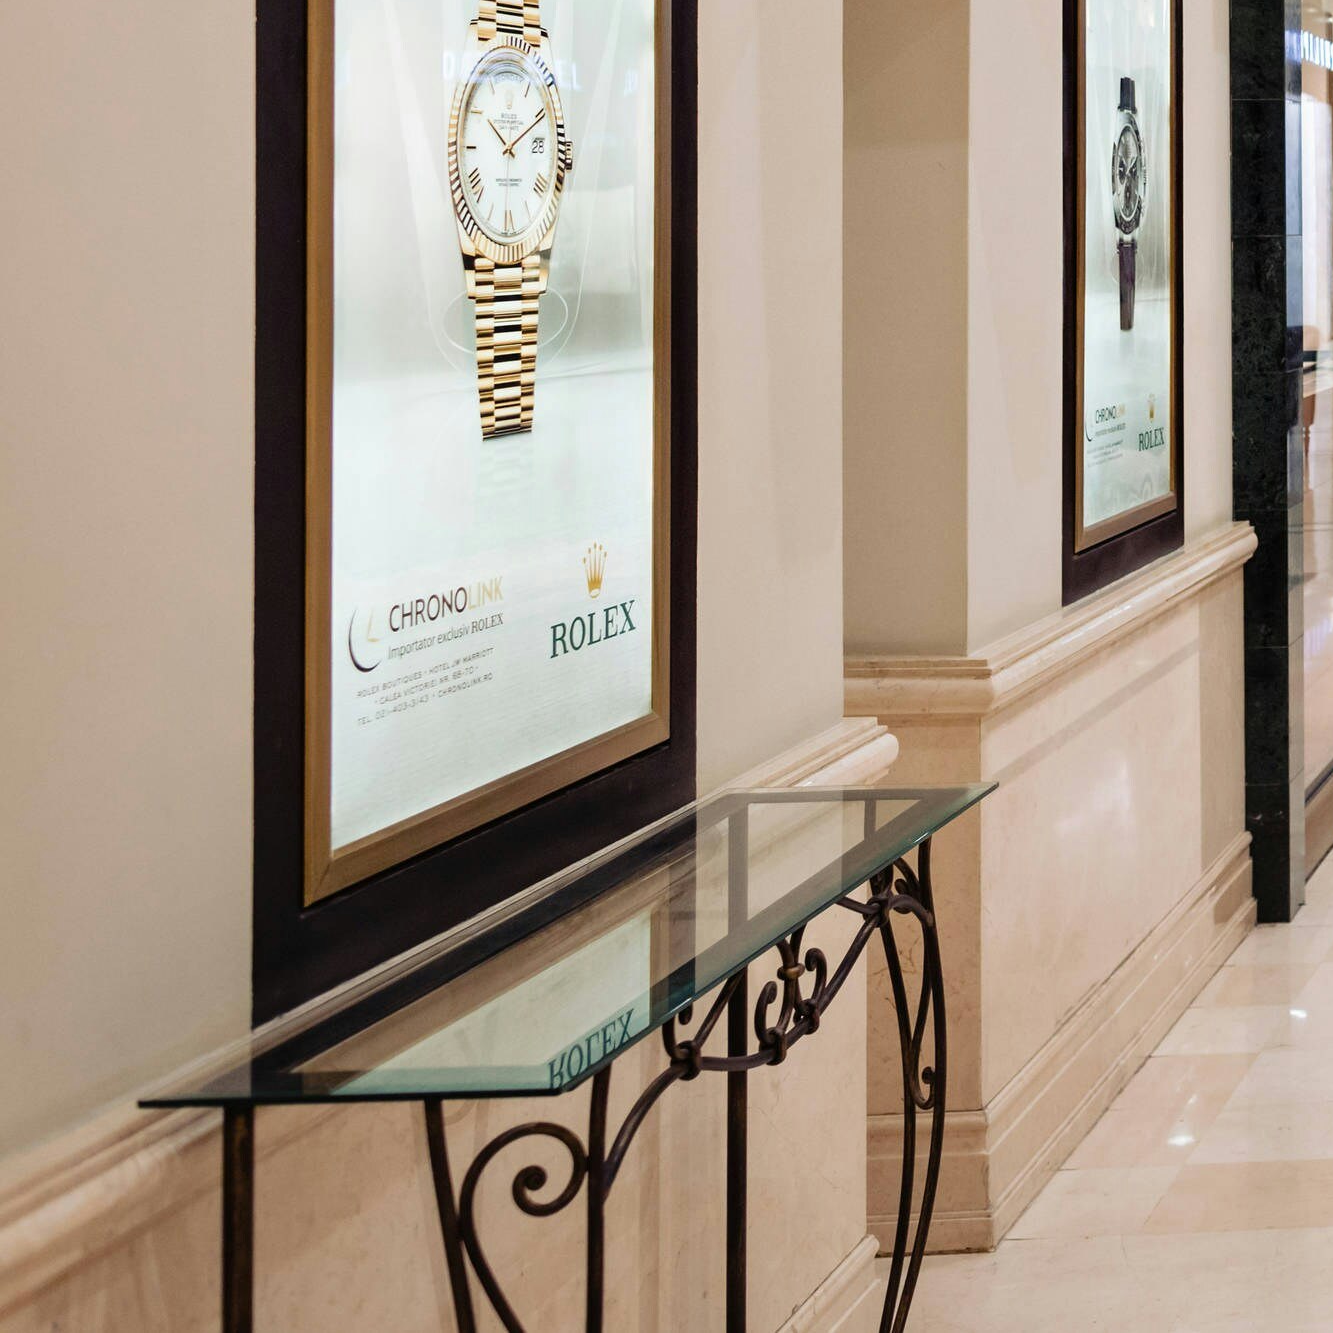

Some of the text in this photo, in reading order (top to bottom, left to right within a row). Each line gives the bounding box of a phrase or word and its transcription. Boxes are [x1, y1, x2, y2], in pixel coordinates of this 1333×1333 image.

[1138, 426, 1165, 452] ROLEX
[389, 576, 505, 632] CHRONOLINK
[550, 599, 637, 659] ROLEX
[387, 612, 505, 660] Importator exclusiv ROLEX
